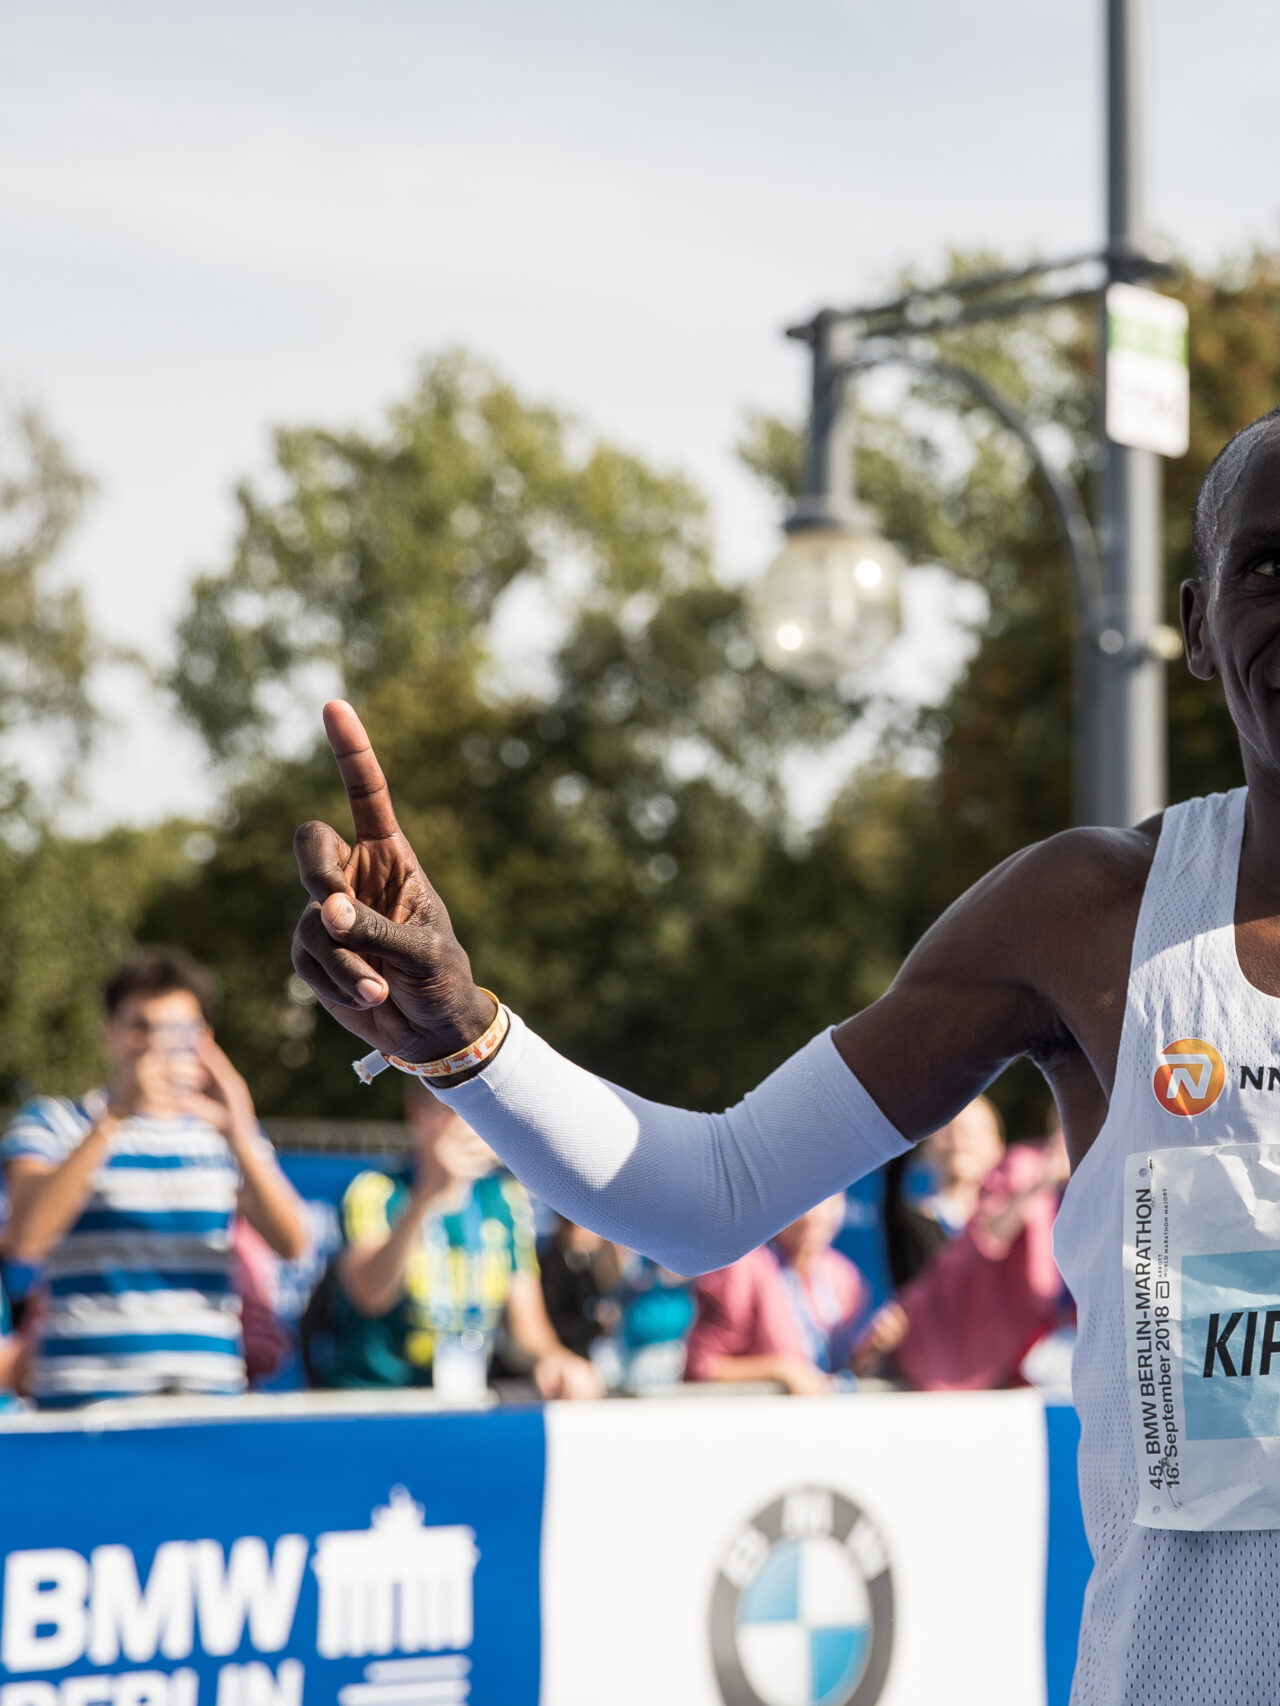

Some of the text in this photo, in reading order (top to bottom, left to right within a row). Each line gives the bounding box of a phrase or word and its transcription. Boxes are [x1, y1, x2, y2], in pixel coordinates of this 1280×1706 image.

[1136, 1188, 1155, 1397] BERLIN-MARATHON
[1155, 1306, 1170, 1351] 2018
[1143, 1401, 1161, 1455] BMW
[1158, 1355, 1178, 1458] September
[1, 1533, 310, 1674] BMW
